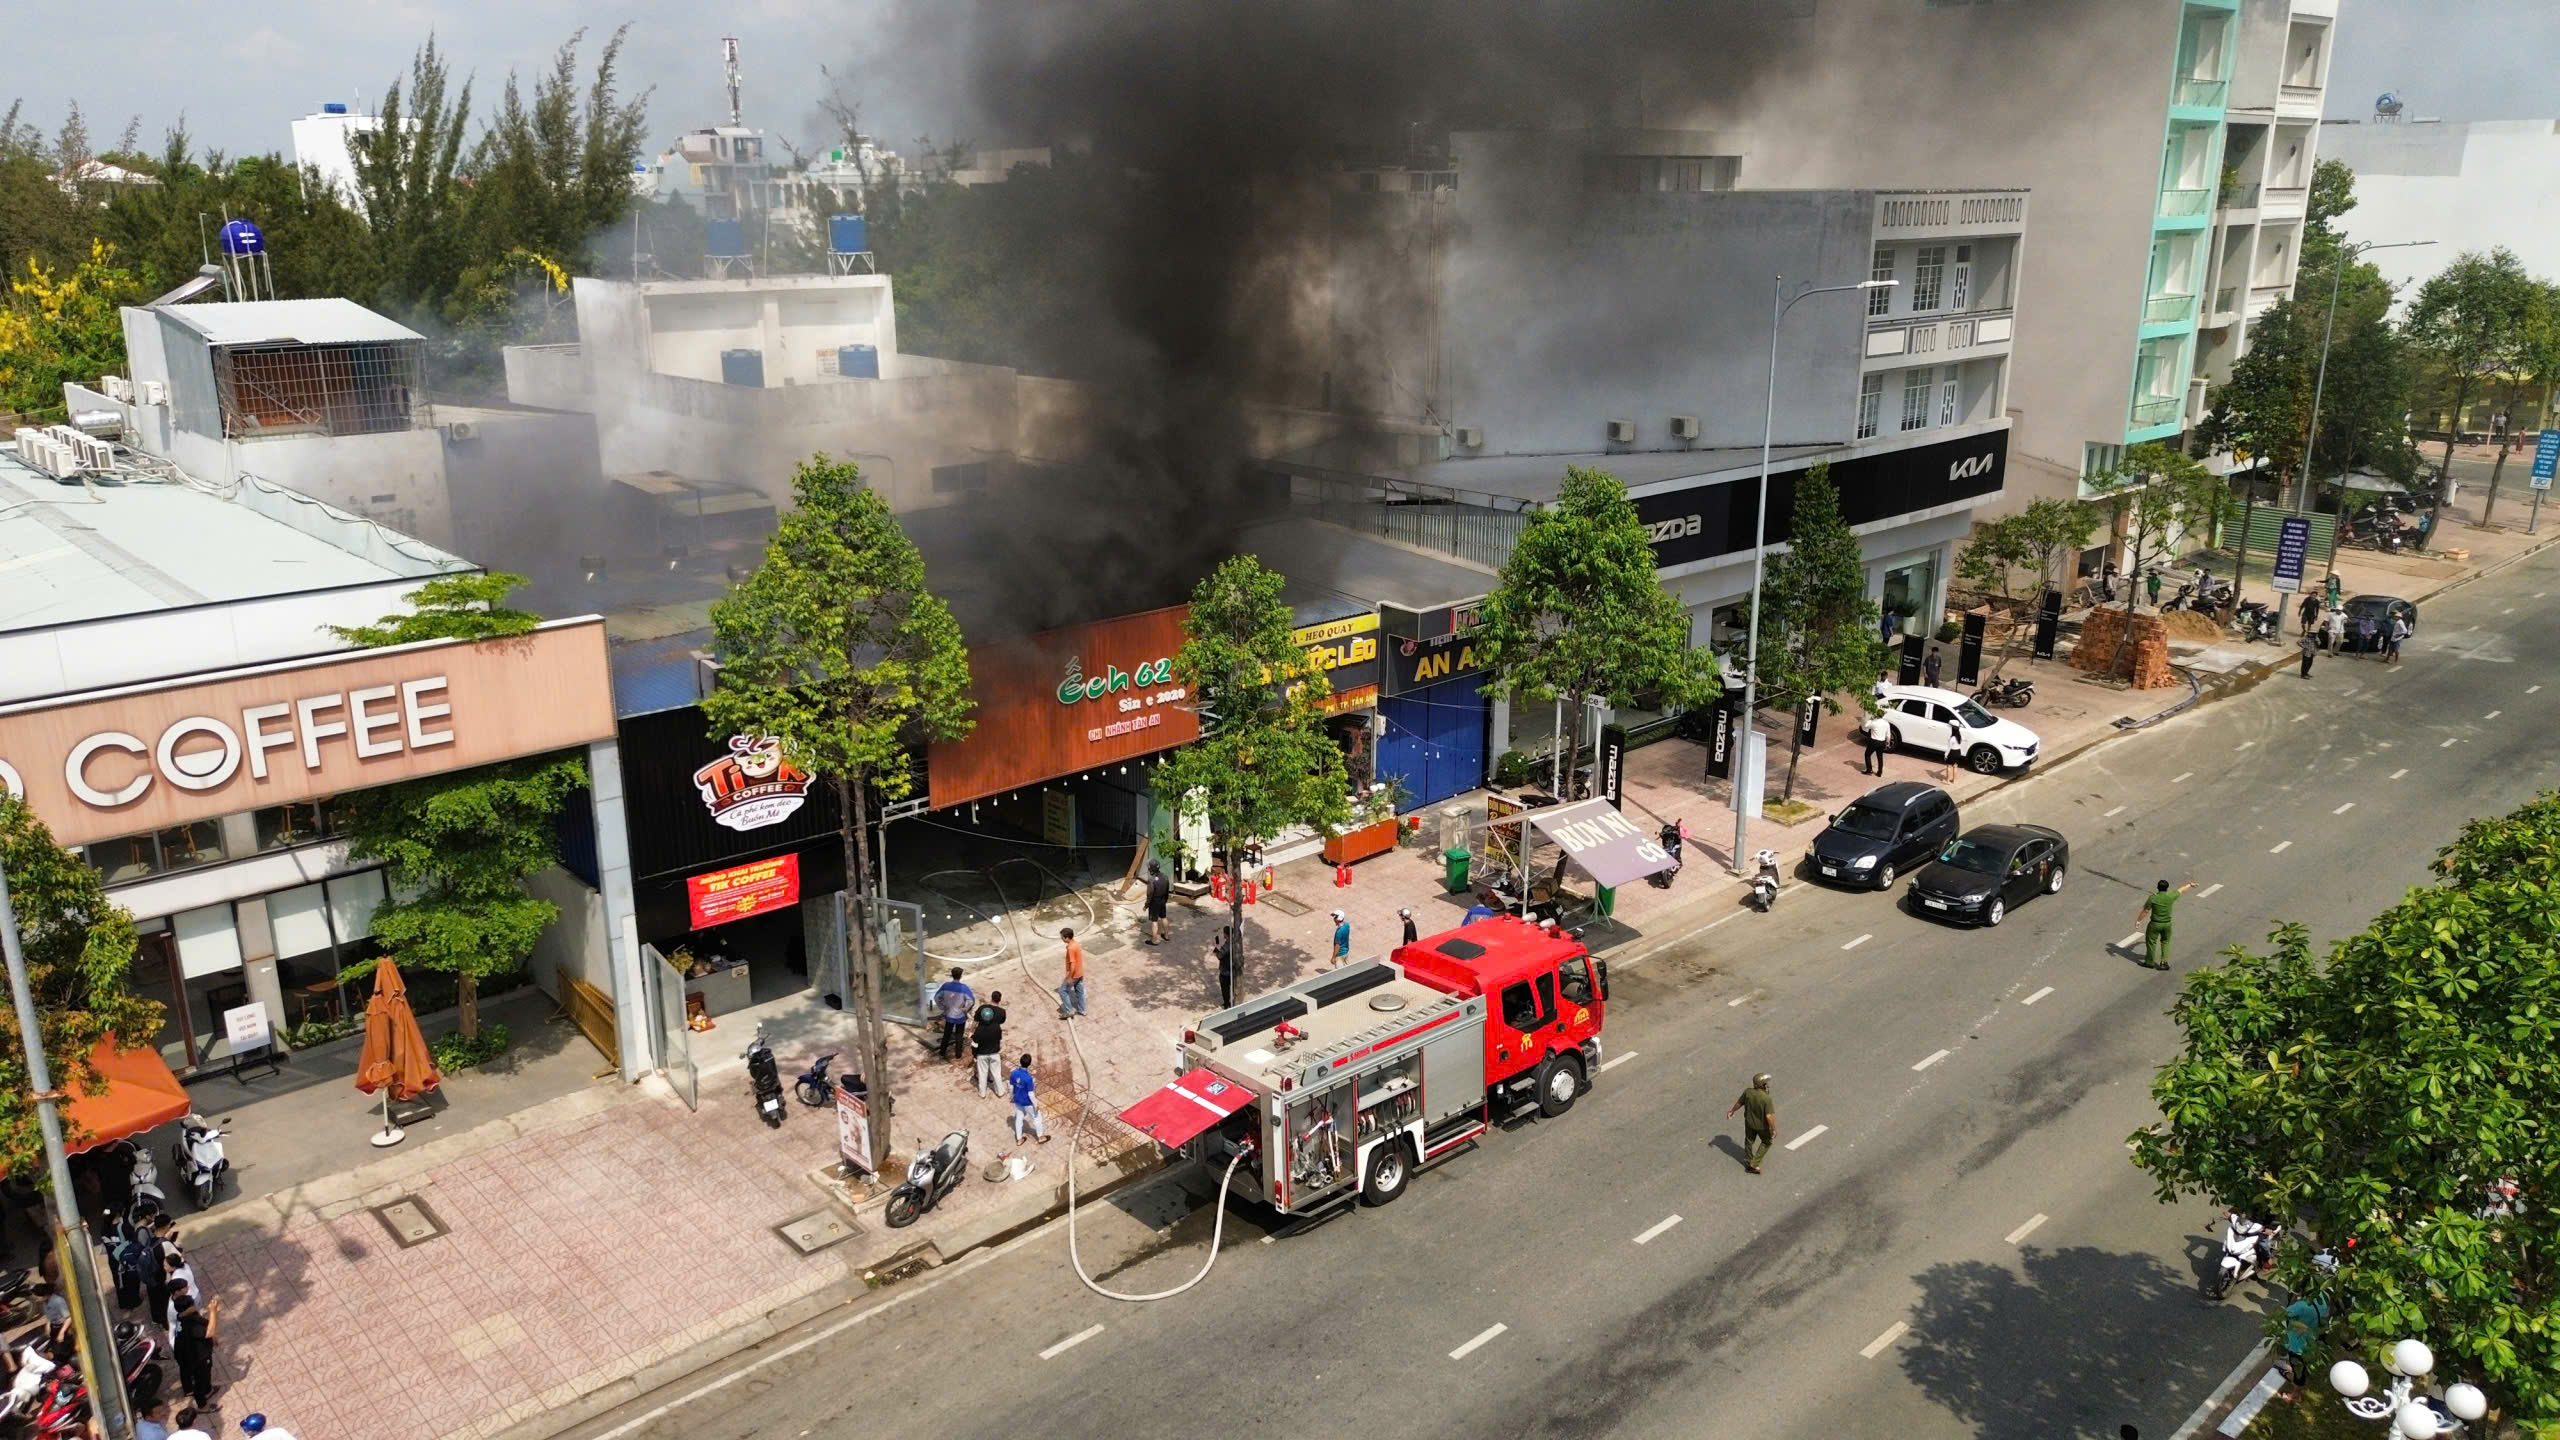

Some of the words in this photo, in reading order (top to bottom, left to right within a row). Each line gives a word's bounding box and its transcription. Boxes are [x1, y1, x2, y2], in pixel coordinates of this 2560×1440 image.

[1949, 453, 1993, 480] KIA
[1305, 628, 1325, 642] HEO
[1327, 622, 1353, 638] QUAY
[1338, 636, 1377, 667] LÈO
[1414, 650, 1451, 681] AN
[1456, 645, 1484, 671] A
[1134, 657, 1172, 687] 62
[1156, 688, 1186, 704] 2020
[1149, 713, 1161, 727] AN
[65, 675, 455, 807] COFFEE
[1714, 709, 1728, 763] mazda
[1606, 744, 1619, 801] mazda
[733, 784, 783, 801] COFFEE
[1551, 817, 1613, 853] BÚN
[1636, 837, 1667, 863] CÔ
[731, 867, 777, 887] COFFEE
